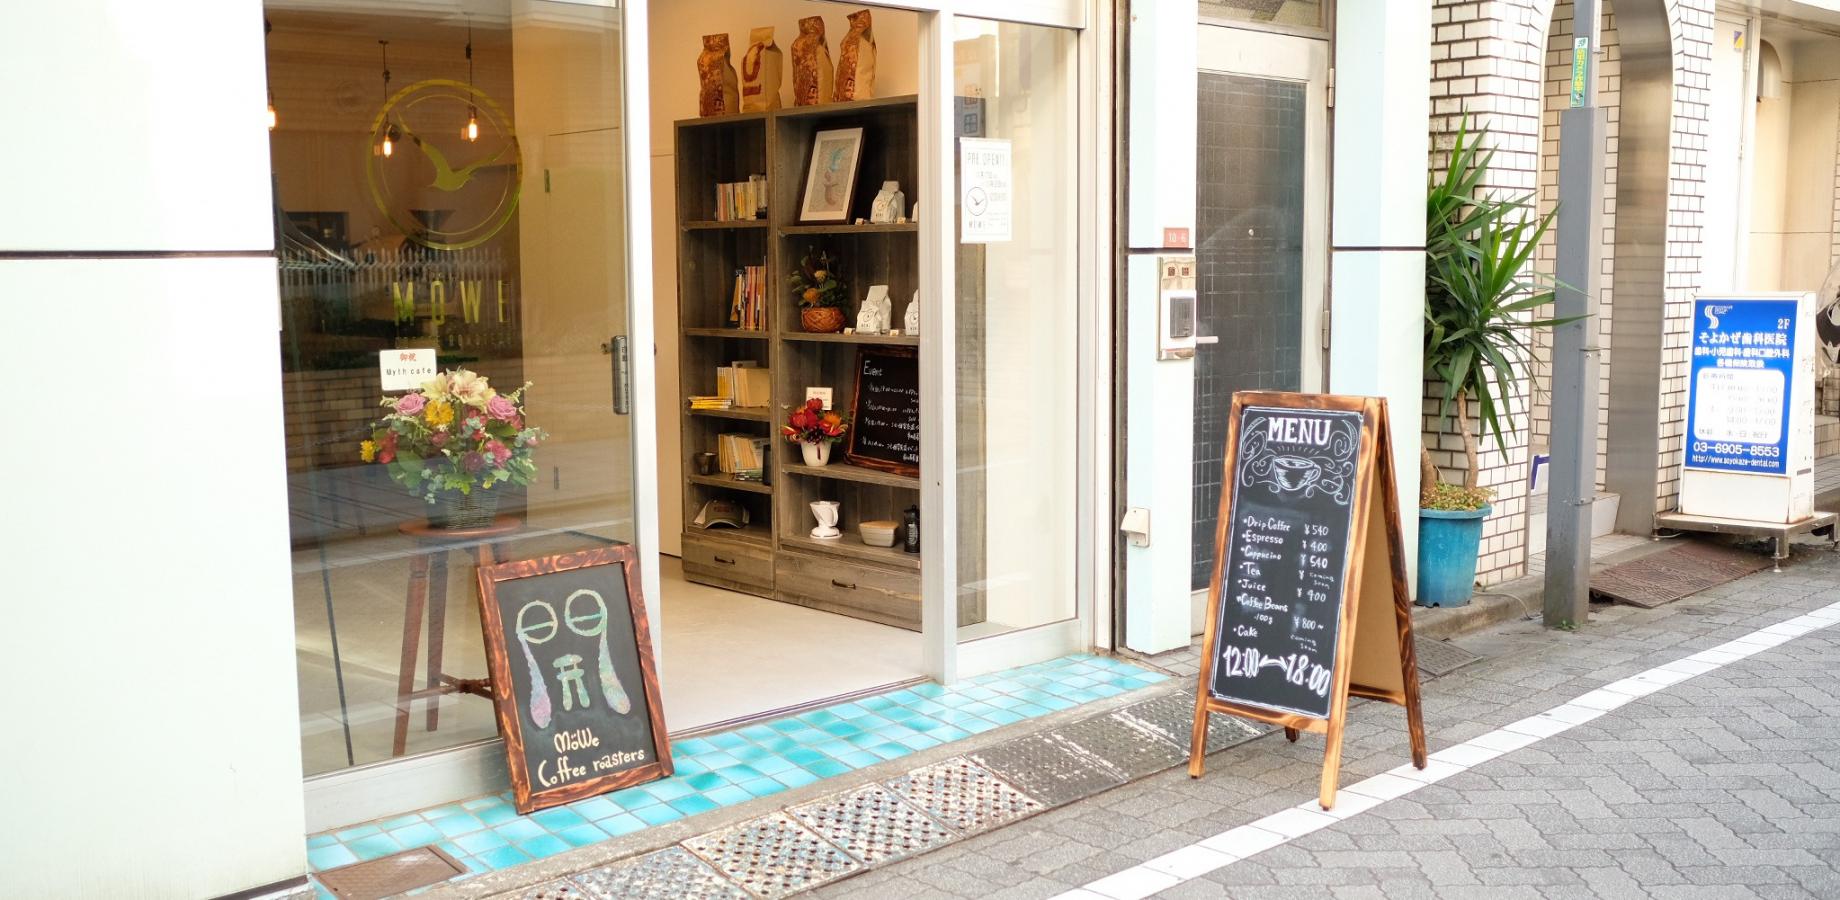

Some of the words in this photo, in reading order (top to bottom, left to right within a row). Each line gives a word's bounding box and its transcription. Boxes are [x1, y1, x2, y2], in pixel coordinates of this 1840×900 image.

[1777, 318, 1791, 330] 2F
[1699, 331, 1788, 346] そよかぜ歯科医院
[1267, 416, 1332, 446] MENU
[1693, 441, 1780, 458] 03-6905-8553
[1247, 515, 1267, 531] Drip
[1245, 529, 1284, 545] Espresso
[1242, 561, 1261, 576] Tea
[1241, 578, 1267, 591] Juice
[1237, 624, 1259, 638] Cake
[1223, 645, 1260, 678] 12:00
[1286, 653, 1331, 698] 18:00
[537, 756, 587, 787] Coffee
[592, 749, 645, 772] roasters
